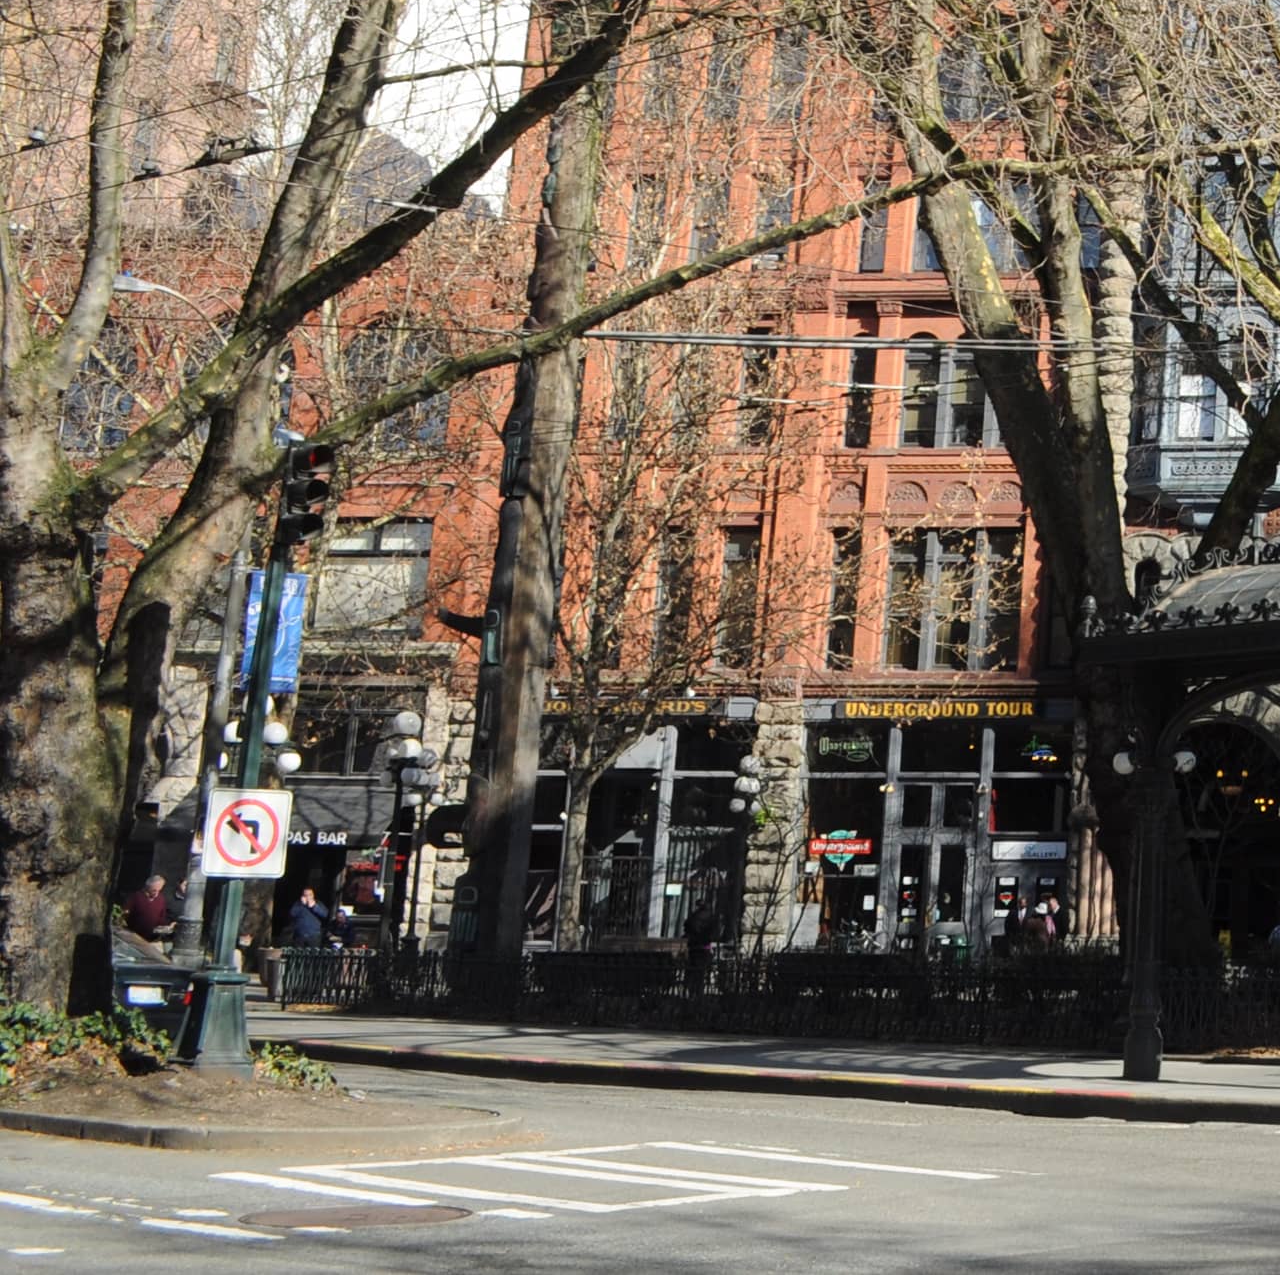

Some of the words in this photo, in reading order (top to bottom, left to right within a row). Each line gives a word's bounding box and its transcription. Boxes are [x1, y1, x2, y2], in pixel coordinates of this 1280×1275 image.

[845, 701, 979, 718] UNDERGROUND
[986, 701, 1034, 716] TOUR
[316, 831, 348, 845] BAR
